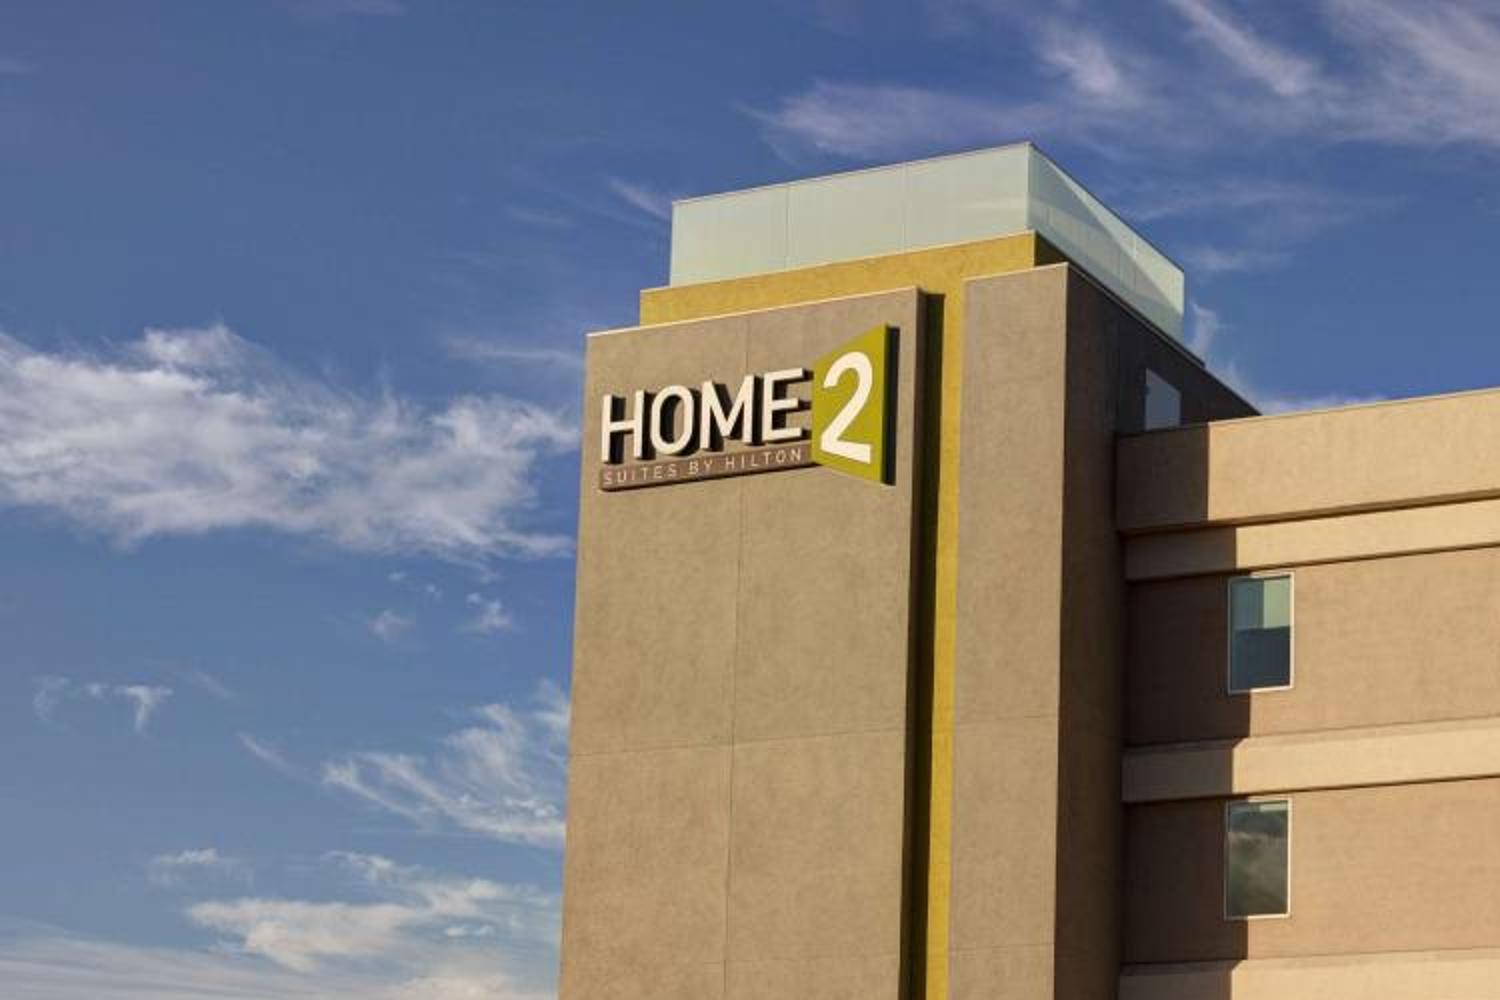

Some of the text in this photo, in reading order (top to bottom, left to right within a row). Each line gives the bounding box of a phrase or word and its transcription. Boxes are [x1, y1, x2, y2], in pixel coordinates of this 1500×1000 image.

[602, 351, 873, 464] HOME 2
[604, 448, 800, 485] SUITES BY HILTON
